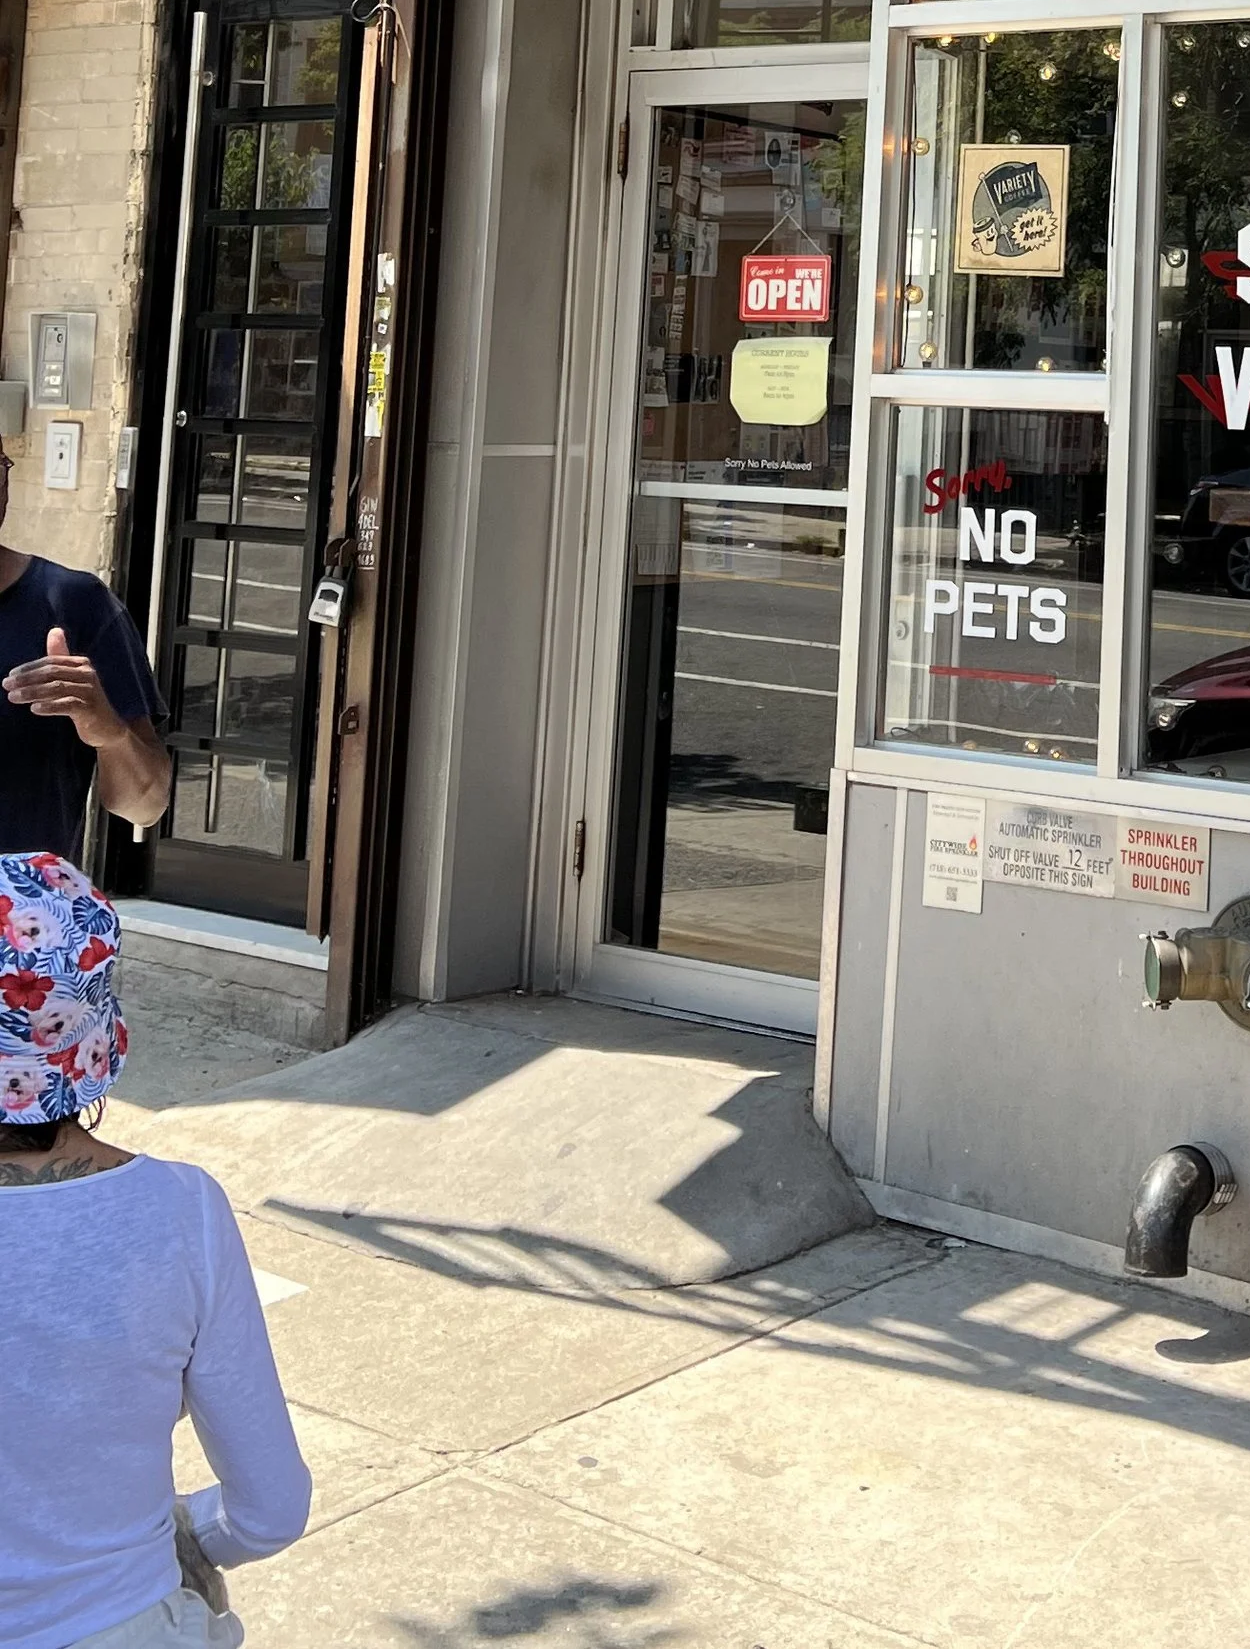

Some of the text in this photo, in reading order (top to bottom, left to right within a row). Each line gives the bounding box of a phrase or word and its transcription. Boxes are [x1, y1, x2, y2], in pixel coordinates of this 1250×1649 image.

[993, 170, 1036, 204] VARIETY
[1004, 189, 1030, 203] COFFEE
[1023, 228, 1048, 242] here!
[794, 268, 823, 280] WE'RE
[747, 278, 823, 312] OPEN
[724, 457, 812, 472] Sorry No Pets Allowed
[960, 506, 1037, 565] NO
[924, 579, 1067, 644] PETS
[1026, 810, 1073, 828] CURB VALVE
[999, 821, 1102, 849] AUTOMATIC SPRINKLER
[1128, 828, 1197, 852] SPRINKLER
[988, 846, 1111, 876] SHUT OFF VALVE 12 FEET
[1120, 849, 1205, 876] THROUGHOUT
[1003, 862, 1093, 888] OPPOSITE THIS SIGN
[1132, 874, 1191, 896] BUILDING
